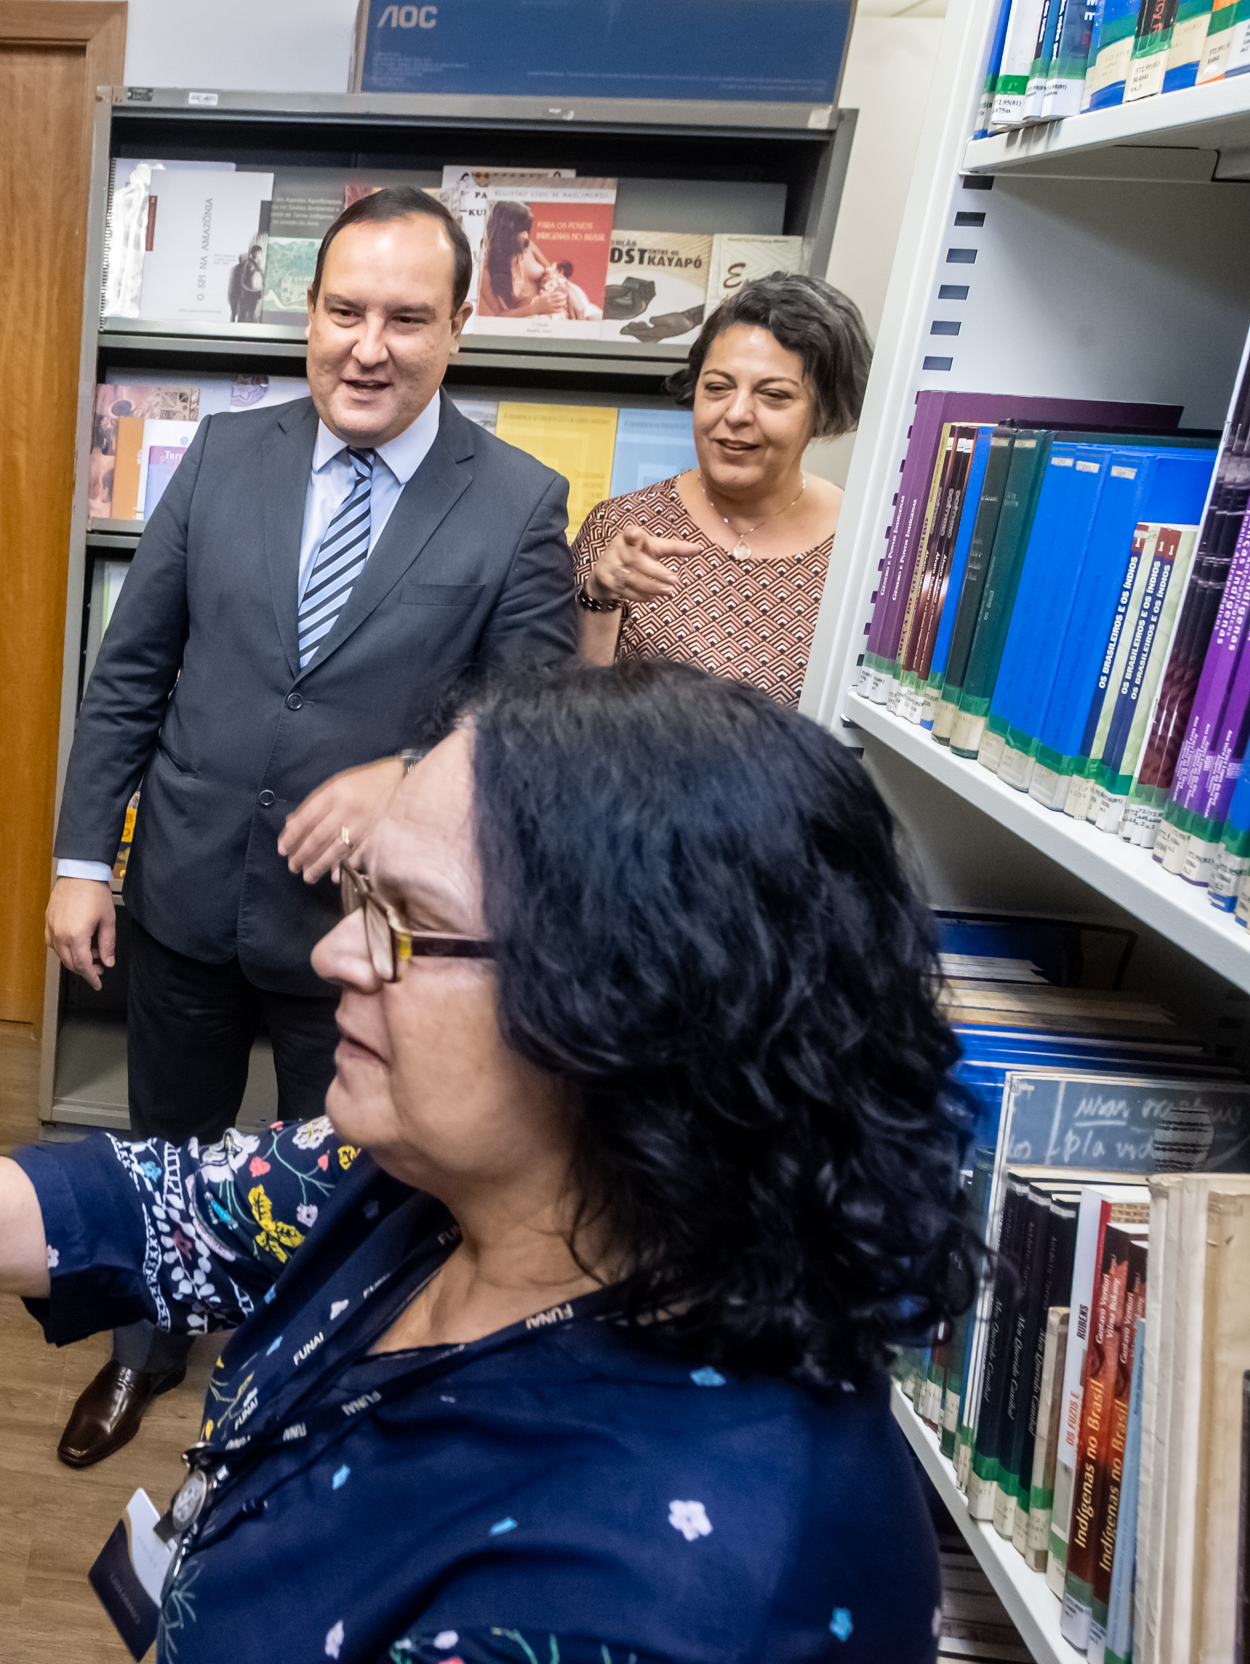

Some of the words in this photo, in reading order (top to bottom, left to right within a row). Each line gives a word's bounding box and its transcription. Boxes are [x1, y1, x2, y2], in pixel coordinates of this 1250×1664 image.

[377, 5, 438, 29] AOC
[201, 197, 214, 251] AMAZÔNIA
[537, 221, 555, 229] PARA
[557, 221, 567, 229] OS
[572, 233, 582, 241] NO
[199, 256, 209, 270] NA
[609, 247, 647, 265] DST
[647, 255, 702, 269] KAYAPÓ
[197, 274, 206, 289] SPI
[197, 294, 205, 302] O
[1135, 537, 1141, 548] 1
[1158, 541, 1165, 552] 1
[1168, 544, 1175, 556] 1
[1123, 556, 1138, 589] ÍNDIOS
[1146, 560, 1161, 594] ÍNDIOS
[1156, 564, 1171, 598] ÍNDIOS
[1120, 590, 1129, 604] OS
[1143, 595, 1152, 609] OS
[1153, 600, 1162, 613] OS
[1214, 551, 1239, 631] Antropológicos
[1118, 605, 1126, 613] E
[1140, 610, 1148, 618] E
[1217, 570, 1243, 644] Indígenas
[1102, 614, 1123, 674] BRASILEIROS
[1125, 619, 1146, 680] BRASILEIROS
[1135, 624, 1155, 685] BRASILEIROS
[1099, 675, 1107, 689] OS
[1121, 681, 1130, 695] OS
[1131, 686, 1139, 700] OS
[1100, 1273, 1110, 1304] Venturi
[1108, 1277, 1121, 1310] Bokany
[525, 1302, 574, 1331] FUNAI
[1076, 1304, 1089, 1341] RUBENS
[1124, 1291, 1135, 1323] Venturi
[1015, 1312, 1025, 1336] Meu
[1096, 1304, 1108, 1345] Gustavo
[1106, 1310, 1117, 1339] Vilma
[293, 1331, 325, 1366] FUNAI
[988, 1321, 1000, 1360] Querido
[1036, 1327, 1046, 1353] Meu
[1120, 1323, 1131, 1364] Gustavo
[1011, 1335, 1023, 1377] Querido
[983, 1361, 994, 1402] Canibal
[1031, 1351, 1044, 1393] Querido
[234, 1398, 259, 1431] FUNAI
[1006, 1378, 1018, 1420] Canibal
[1087, 1379, 1105, 1431] Brasil
[1027, 1394, 1039, 1436] Canibal
[1067, 1399, 1079, 1431] FUZIS
[1112, 1399, 1129, 1454] Brasil
[1066, 1431, 1075, 1447] OS
[1086, 1437, 1098, 1461] no
[1111, 1457, 1123, 1482] no
[1074, 1462, 1096, 1549] Indígenas
[1099, 1483, 1120, 1573] Indígenas
